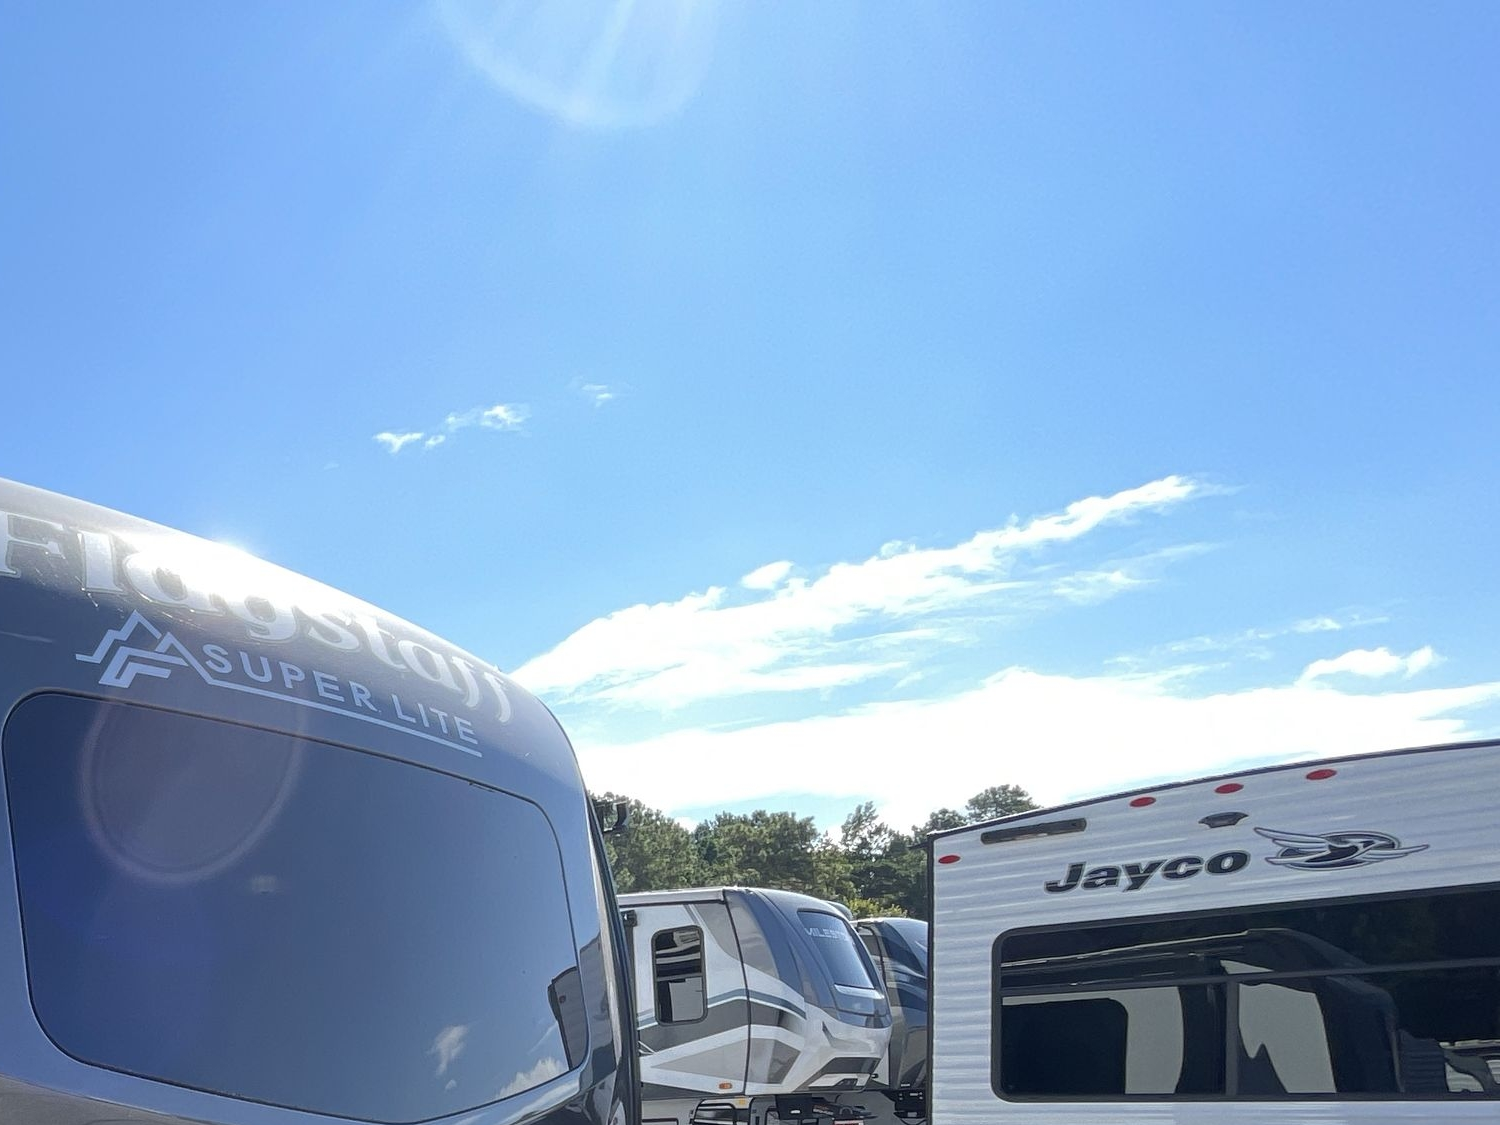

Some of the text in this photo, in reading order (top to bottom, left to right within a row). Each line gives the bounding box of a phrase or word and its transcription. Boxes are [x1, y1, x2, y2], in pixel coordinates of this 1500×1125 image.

[202, 643, 479, 746] SUPER LITE
[1044, 850, 1251, 893] Jayco
